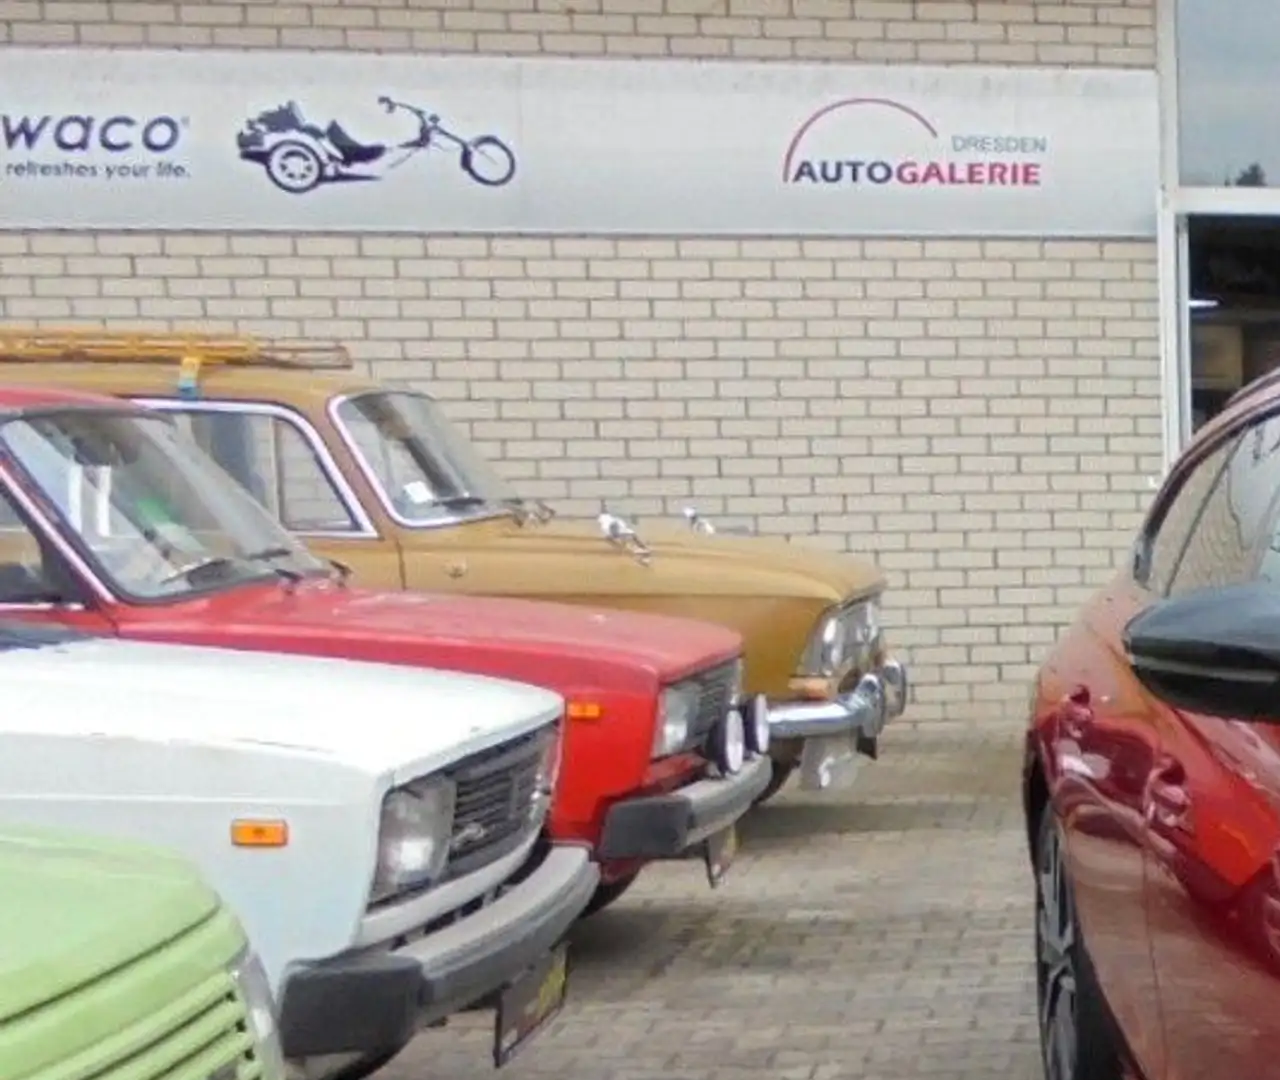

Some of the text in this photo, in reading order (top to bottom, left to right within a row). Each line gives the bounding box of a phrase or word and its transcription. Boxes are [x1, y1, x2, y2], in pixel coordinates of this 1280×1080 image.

[951, 135, 1048, 153] DRESDEN
[6, 161, 191, 180] refreshes your life.
[793, 160, 1042, 186] AUTOGALERIE
